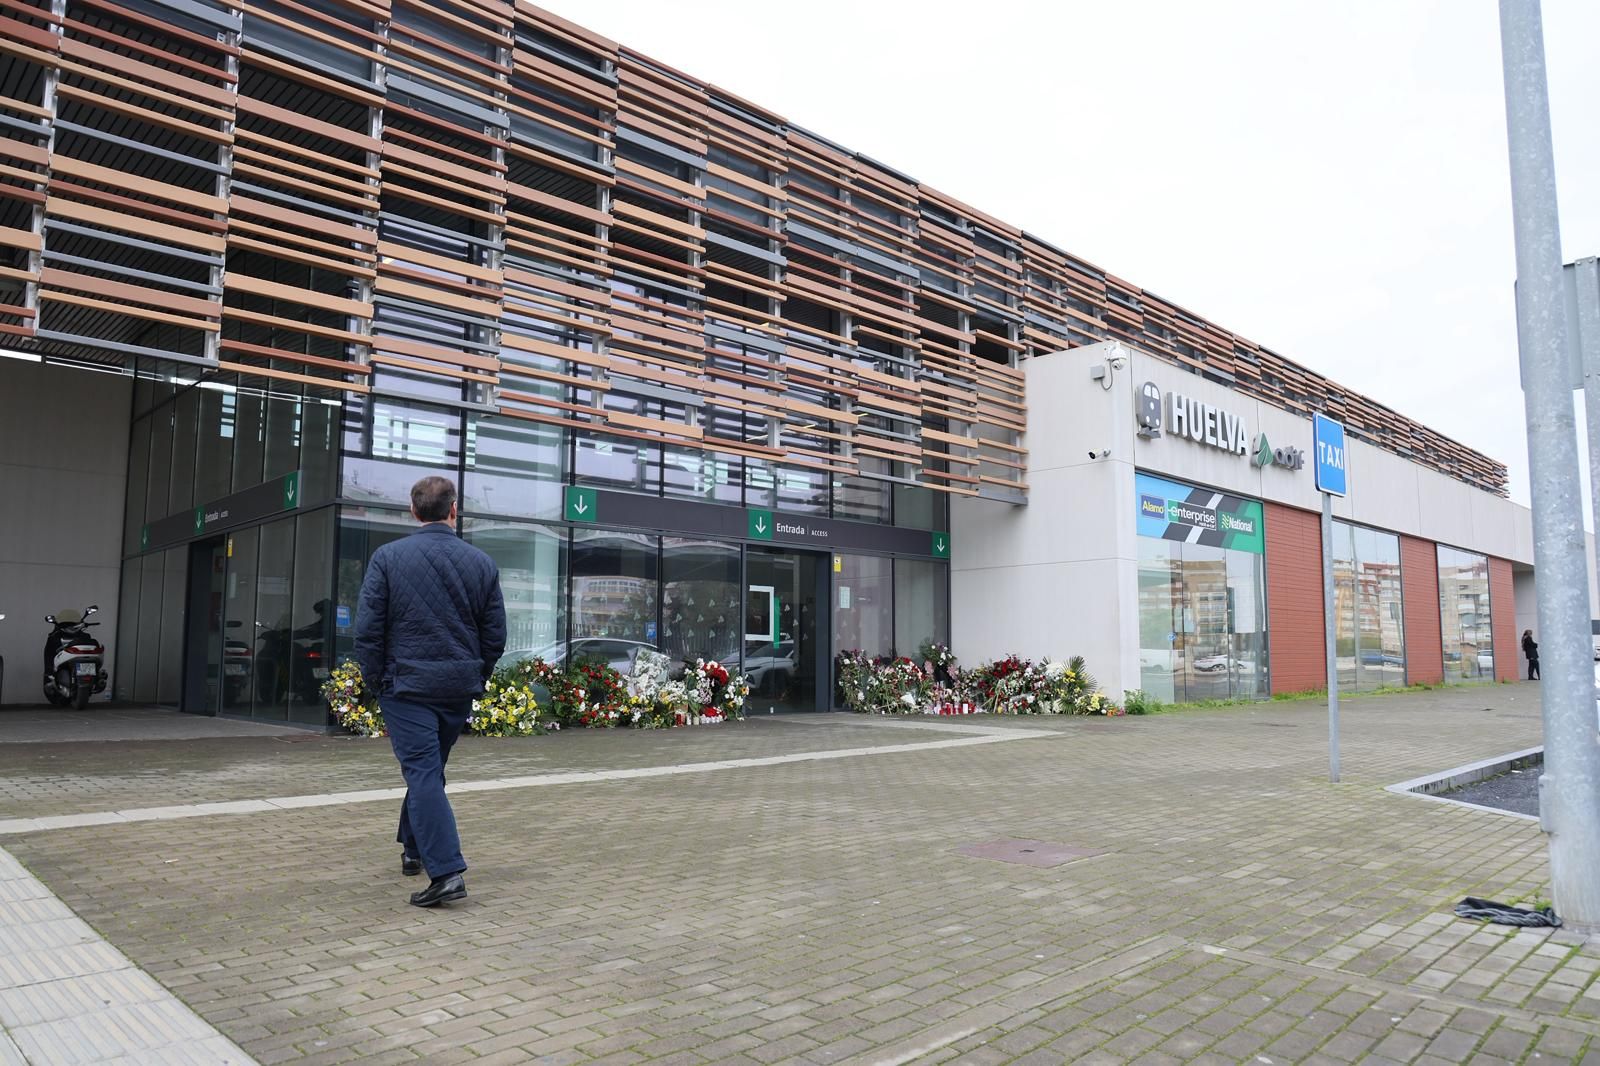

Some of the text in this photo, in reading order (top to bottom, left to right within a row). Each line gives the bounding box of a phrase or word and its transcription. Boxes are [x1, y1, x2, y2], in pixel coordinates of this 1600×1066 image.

[1169, 393, 1249, 456] HUELVA
[1274, 444, 1305, 471] adif
[1319, 440, 1344, 470] TAXI
[1142, 501, 1164, 514] Alamo
[1168, 505, 1216, 524] enterprise
[776, 522, 805, 535] Entrada
[1229, 516, 1253, 532] National
